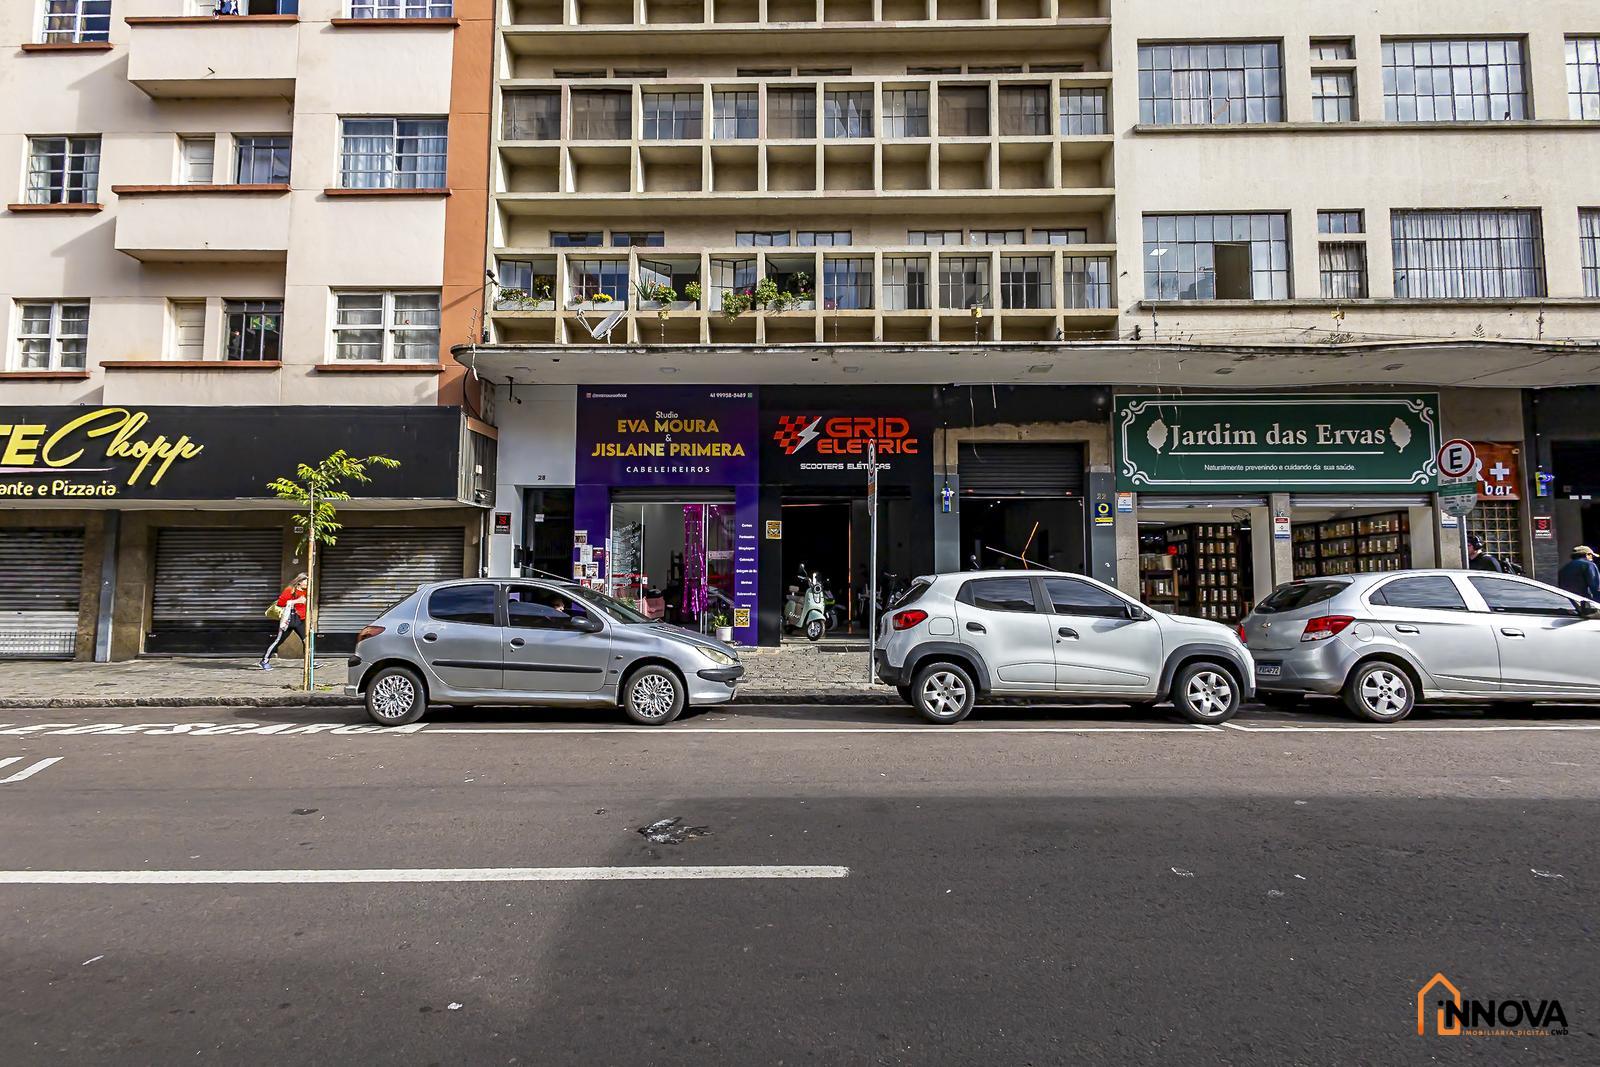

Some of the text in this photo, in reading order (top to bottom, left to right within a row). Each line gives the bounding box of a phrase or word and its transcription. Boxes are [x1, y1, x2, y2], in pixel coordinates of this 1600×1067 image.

[655, 411, 679, 419] Studio
[617, 419, 719, 433] EVA MOURA
[825, 417, 910, 438] GRID
[665, 434, 672, 442] &
[1170, 422, 1386, 450] Jardim das Ervas
[0, 407, 204, 486] E Chopp
[591, 443, 746, 457] JISLAINE PRIMERA
[1449, 447, 1463, 469] E
[847, 461, 891, 470] ELÉTCAS
[1245, 464, 1278, 472] prevenindo
[38, 484, 48, 496] e
[52, 480, 117, 496] Pizzaria
[1484, 480, 1513, 495] bar
